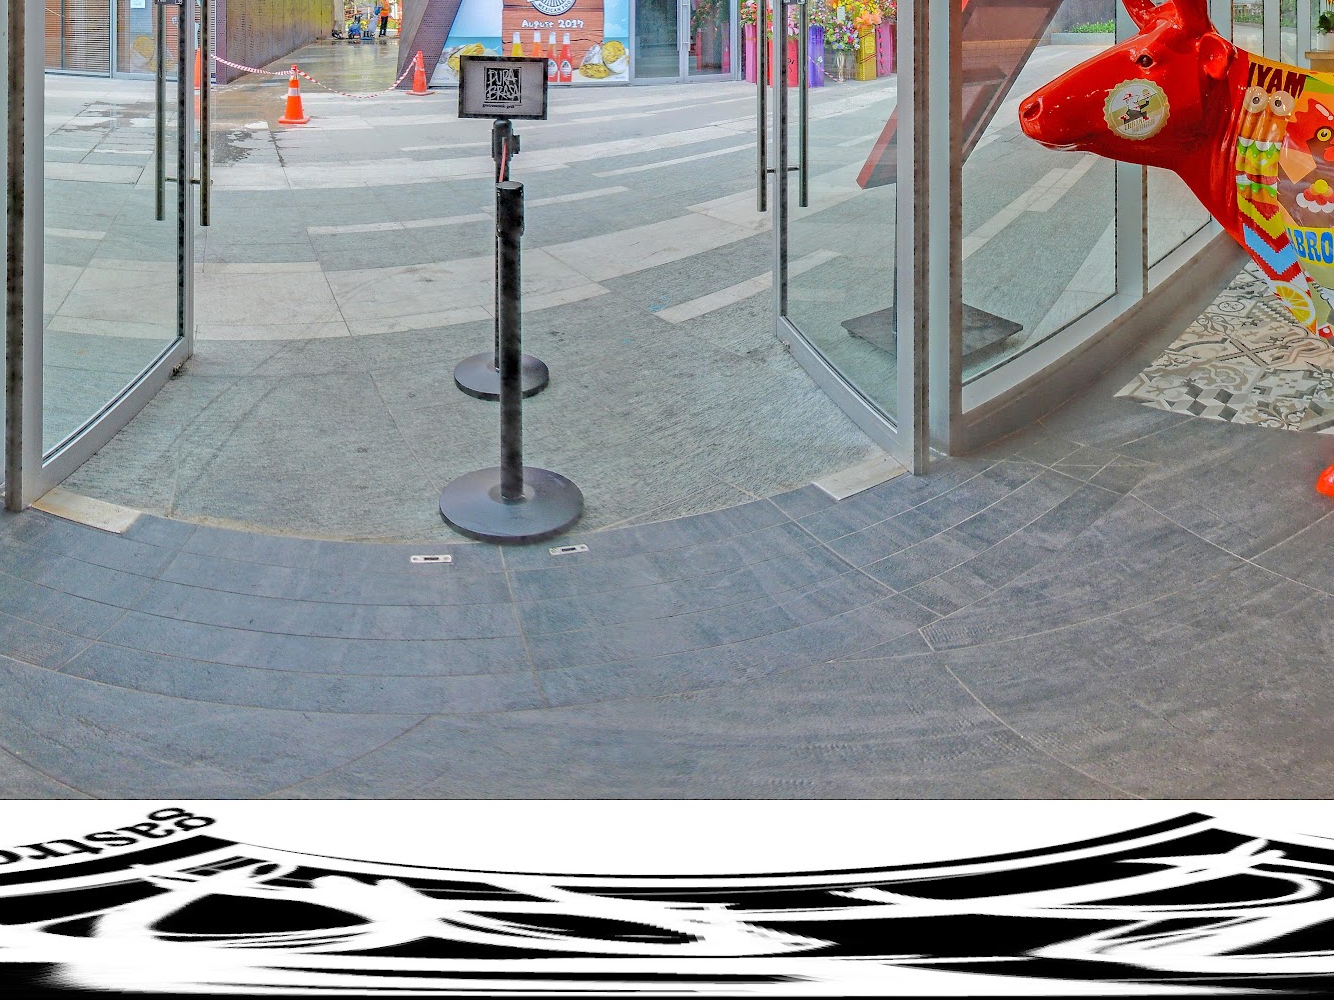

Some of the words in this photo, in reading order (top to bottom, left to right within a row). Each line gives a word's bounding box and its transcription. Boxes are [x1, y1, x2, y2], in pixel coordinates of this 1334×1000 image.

[521, 19, 555, 29] August
[557, 19, 584, 29] 2017
[487, 68, 518, 87] PURA
